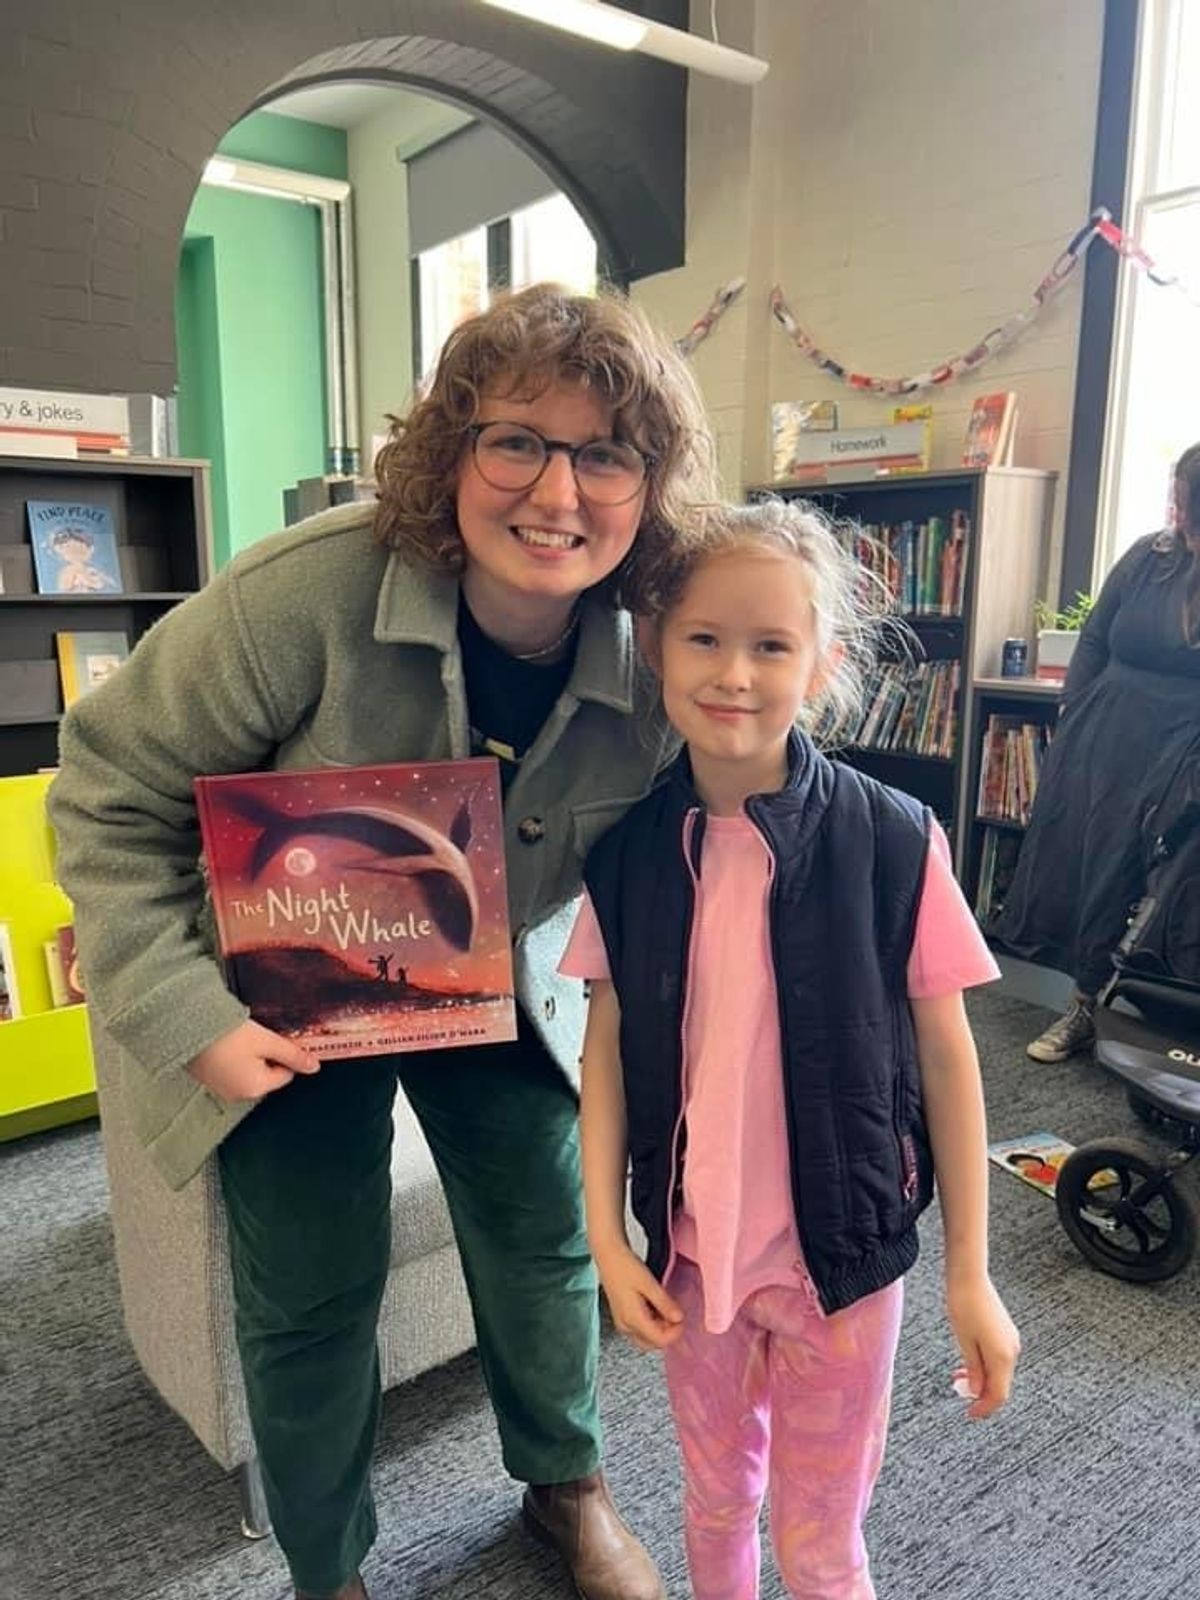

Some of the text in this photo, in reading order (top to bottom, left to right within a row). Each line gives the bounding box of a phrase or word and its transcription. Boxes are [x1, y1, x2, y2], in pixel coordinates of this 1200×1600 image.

[0, 400, 83, 422] y & jokes
[830, 434, 887, 453] Homework
[231, 882, 350, 935] The Night
[329, 908, 432, 950] Whale
